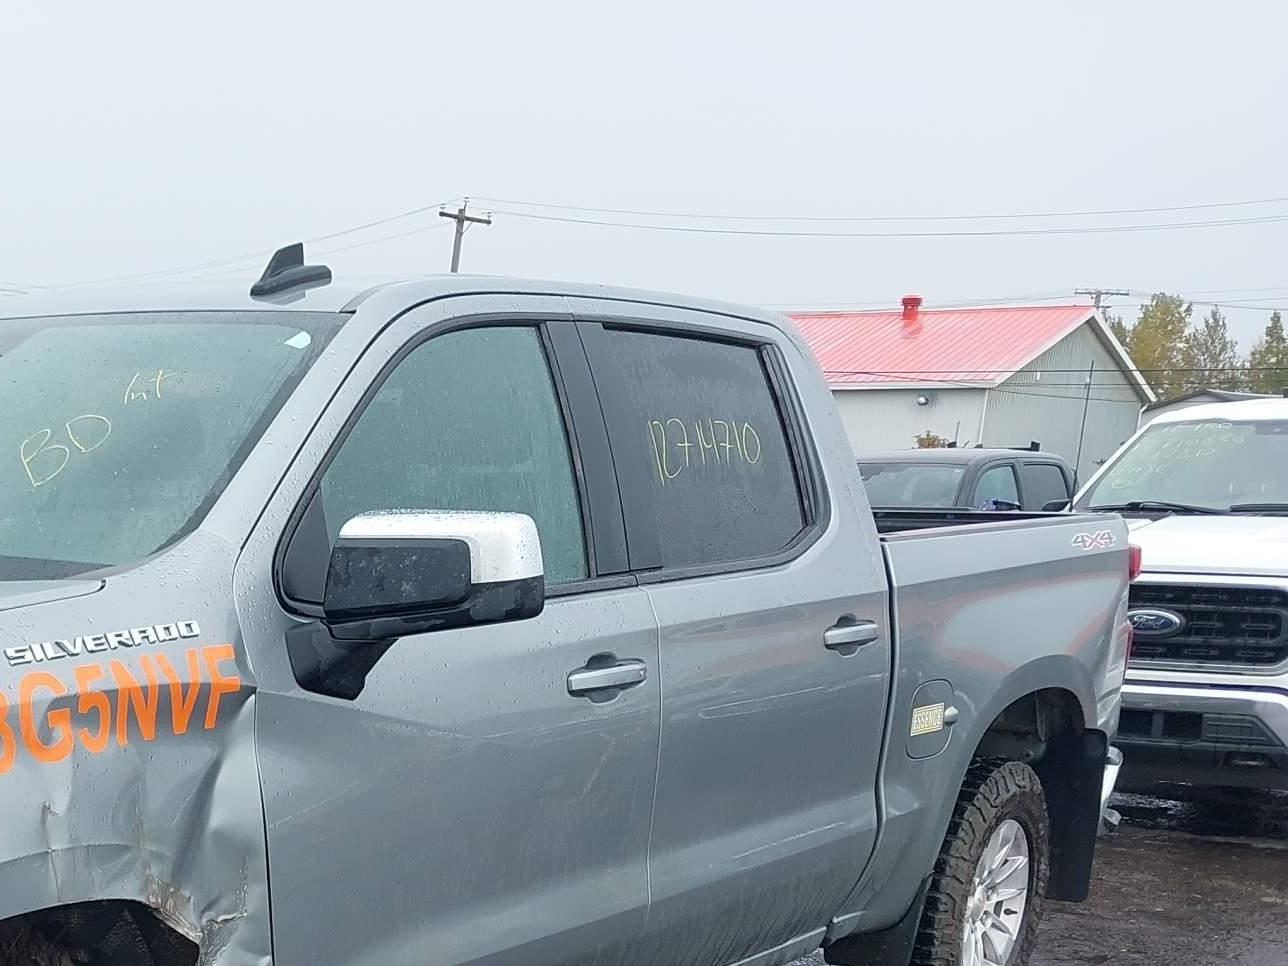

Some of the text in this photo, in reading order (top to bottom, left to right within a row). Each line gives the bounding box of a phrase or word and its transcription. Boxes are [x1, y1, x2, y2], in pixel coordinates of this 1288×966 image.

[20, 414, 112, 488] BD
[647, 417, 761, 487] 12714710
[3, 619, 201, 667] SILVERADO
[1132, 613, 1166, 630] Ford
[913, 708, 943, 731] ESSENCE
